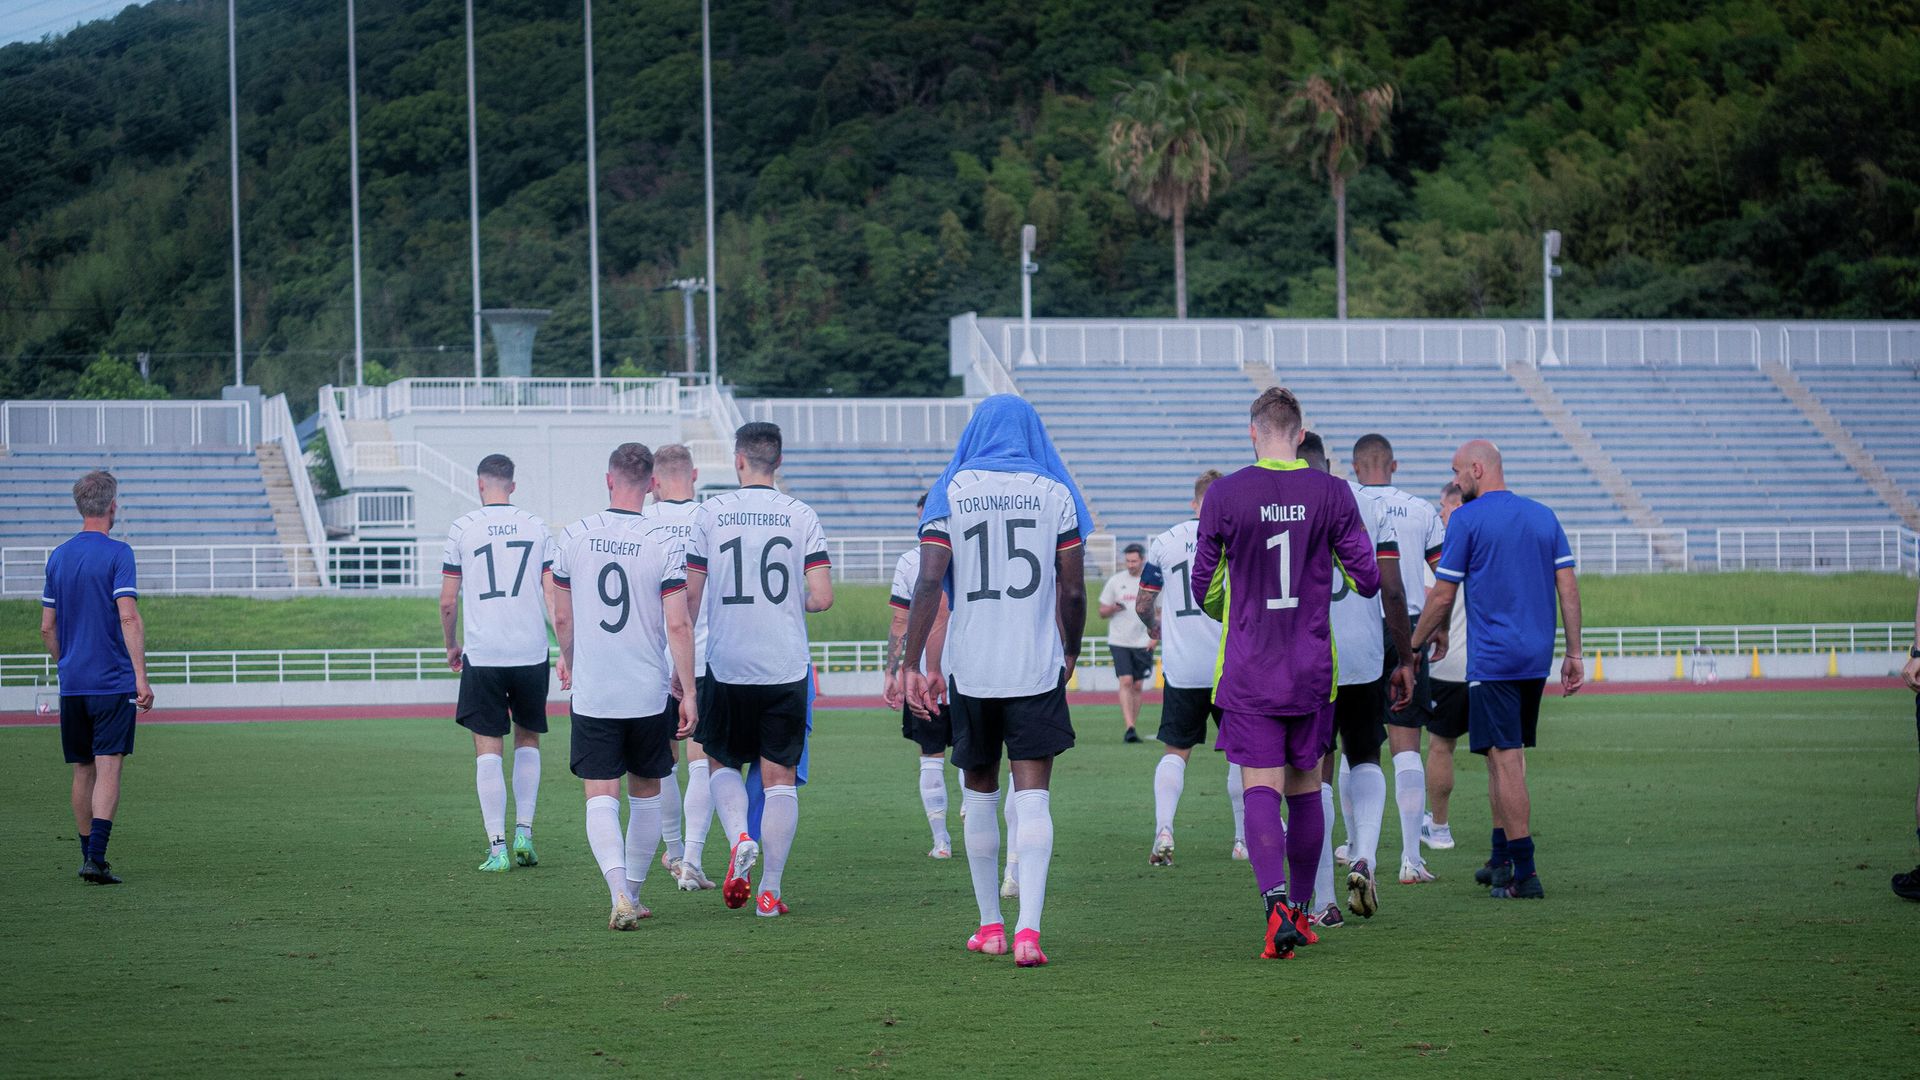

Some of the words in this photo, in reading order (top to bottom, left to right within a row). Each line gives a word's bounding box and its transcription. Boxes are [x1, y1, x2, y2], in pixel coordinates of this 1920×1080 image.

[718, 512, 792, 528] SCHLOTTERBECK
[957, 494, 1041, 514] TORUNARIGHA
[1260, 504, 1306, 522] MÜLLER
[487, 524, 518, 536] STACH
[589, 538, 642, 557] TEUCHERT
[473, 540, 535, 601] 17
[719, 535, 793, 605] 16
[963, 518, 1042, 602] 15
[1266, 529, 1299, 609] 1
[598, 561, 630, 634] 9
